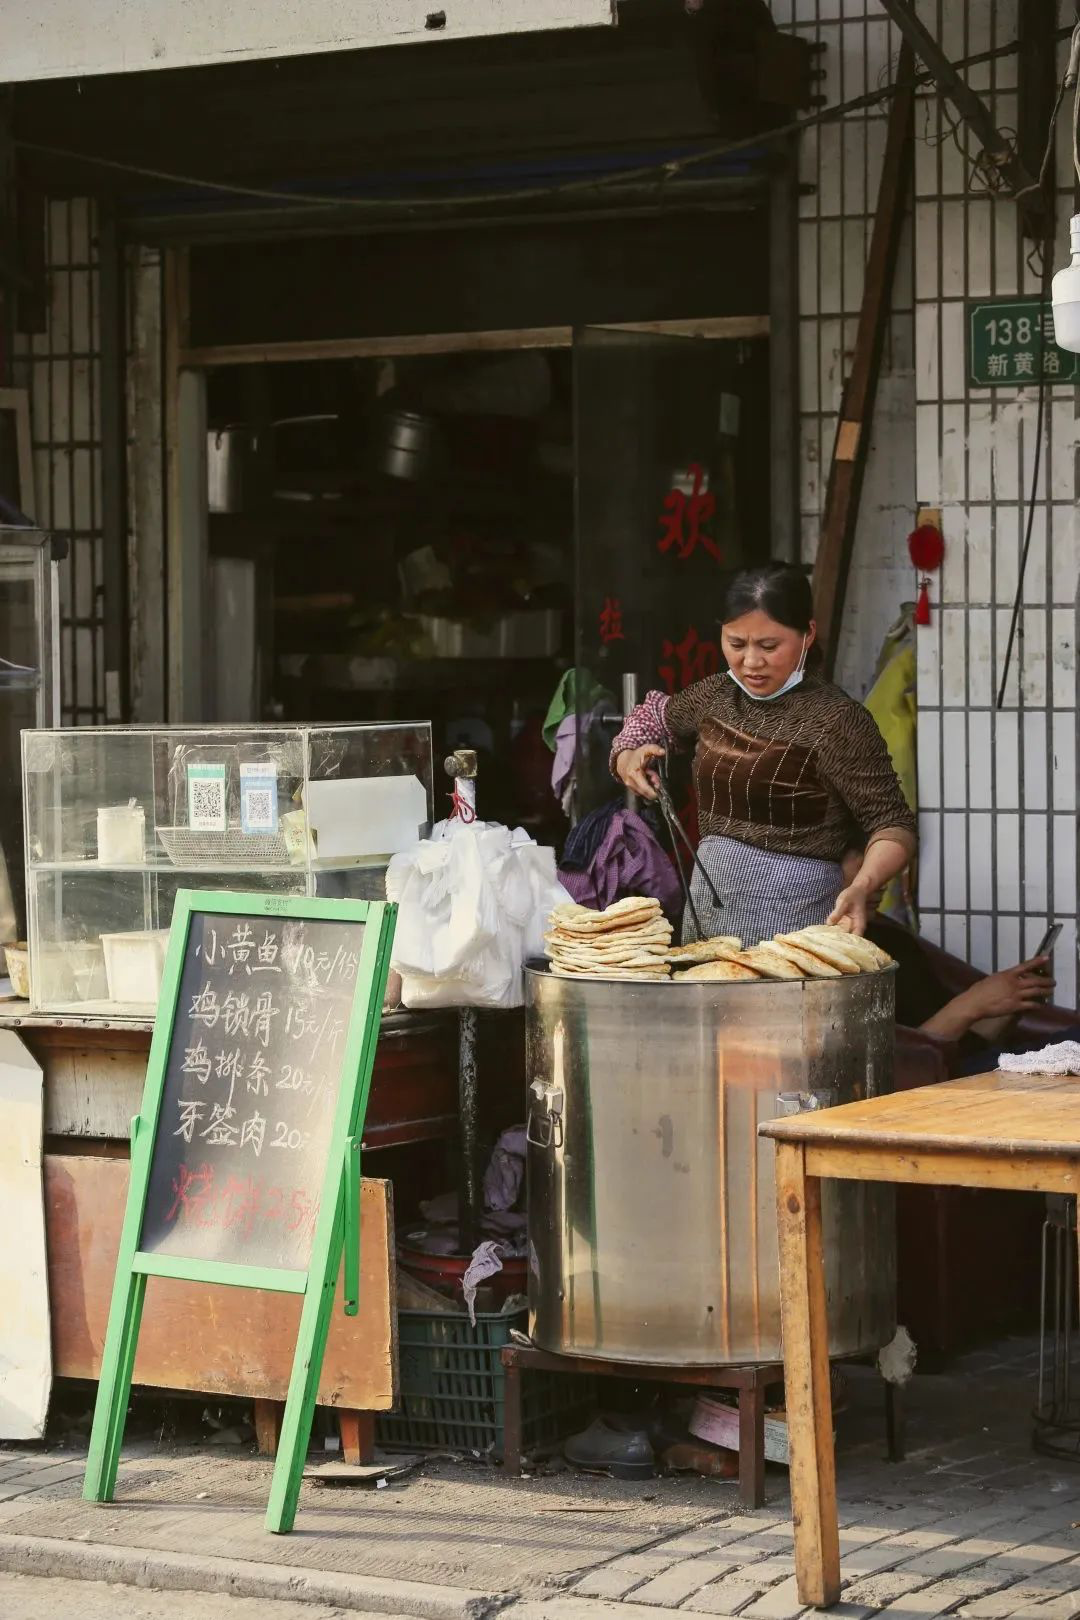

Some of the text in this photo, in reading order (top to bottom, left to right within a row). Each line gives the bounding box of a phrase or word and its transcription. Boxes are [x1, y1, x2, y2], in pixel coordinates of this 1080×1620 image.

[987, 351, 1060, 377] 新黄路
[195, 922, 282, 976] 小黄鱼
[188, 981, 280, 1047] 鸡锁骨
[173, 1099, 266, 1156] 牙签肉
